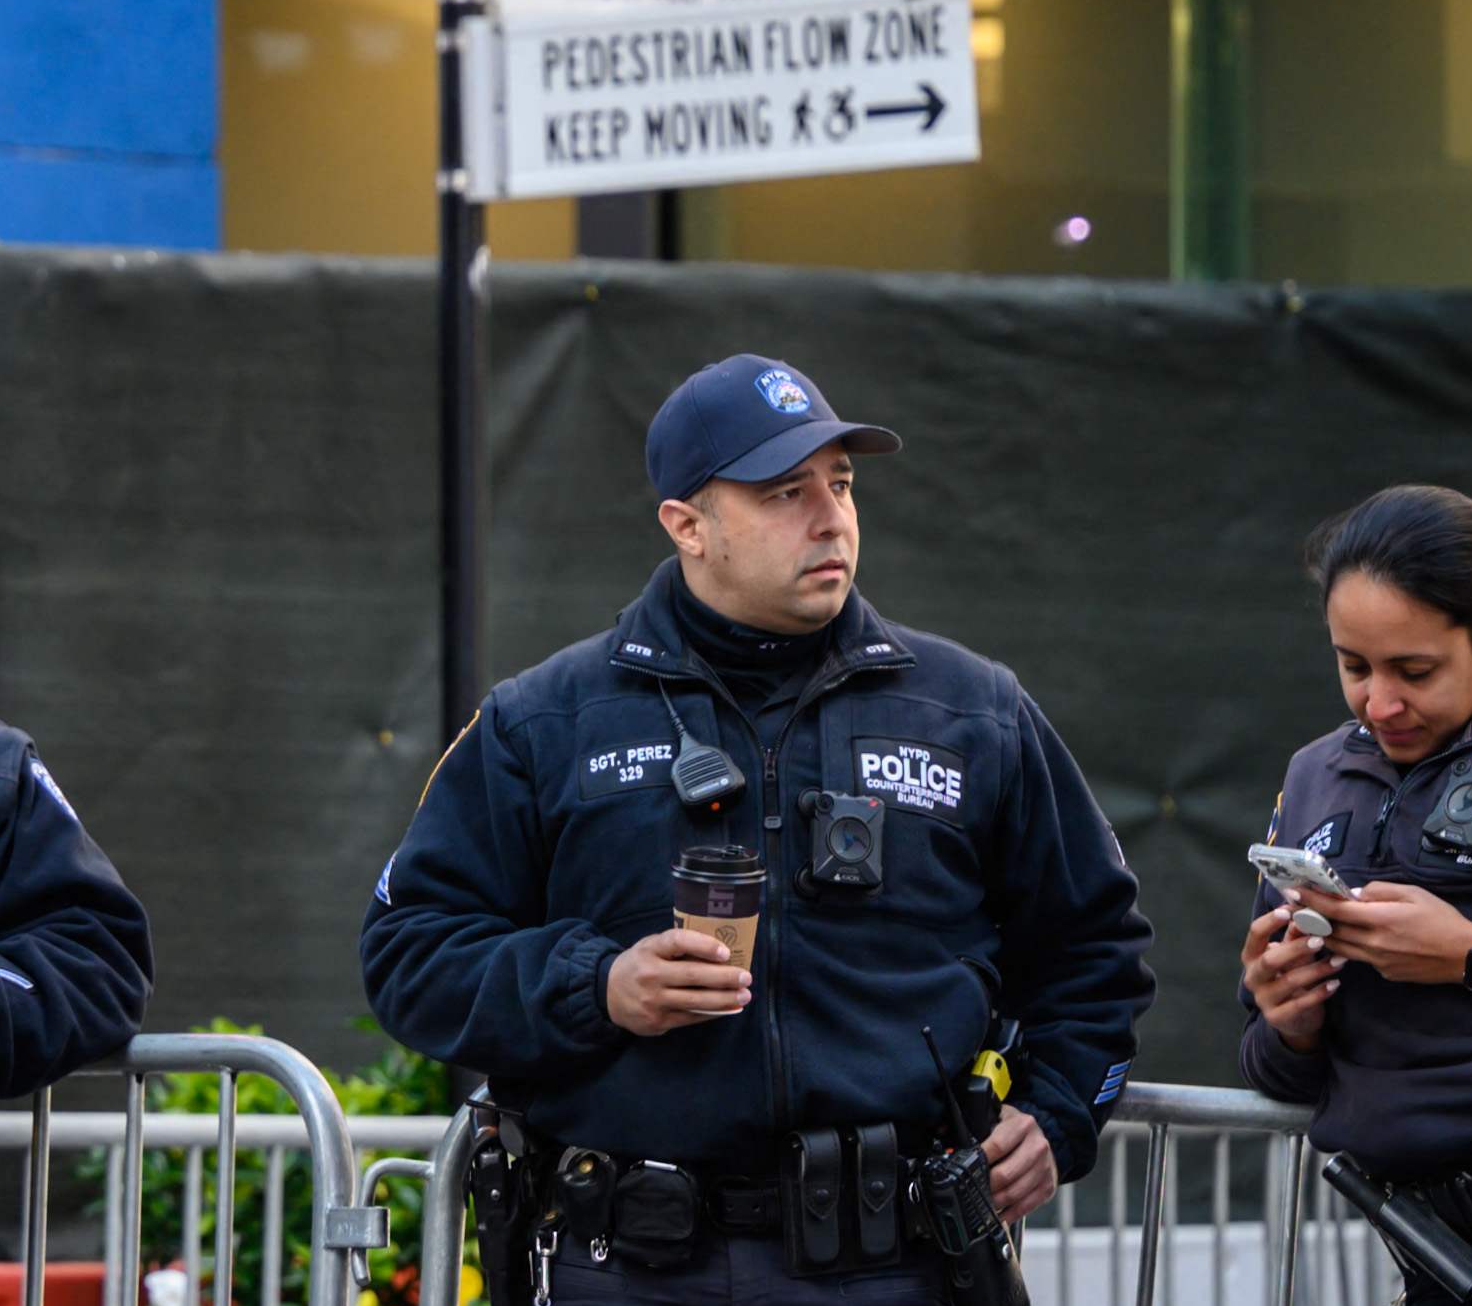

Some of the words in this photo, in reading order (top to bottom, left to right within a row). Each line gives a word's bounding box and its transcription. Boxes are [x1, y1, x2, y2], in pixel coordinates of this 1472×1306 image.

[541, 29, 752, 93] PEDESTRIAN
[763, 18, 851, 72] FLOW
[863, 4, 947, 62] ZONE
[545, 110, 629, 165] KEEP
[644, 100, 772, 153] MOVING
[589, 752, 621, 773] SGT.
[627, 745, 672, 764] PEREZ
[899, 745, 931, 762] NYPD
[619, 765, 644, 783] 329
[860, 753, 962, 800] POLICE
[866, 778, 958, 808] COUNTERTERRORISM
[897, 792, 934, 810] BUREAU
